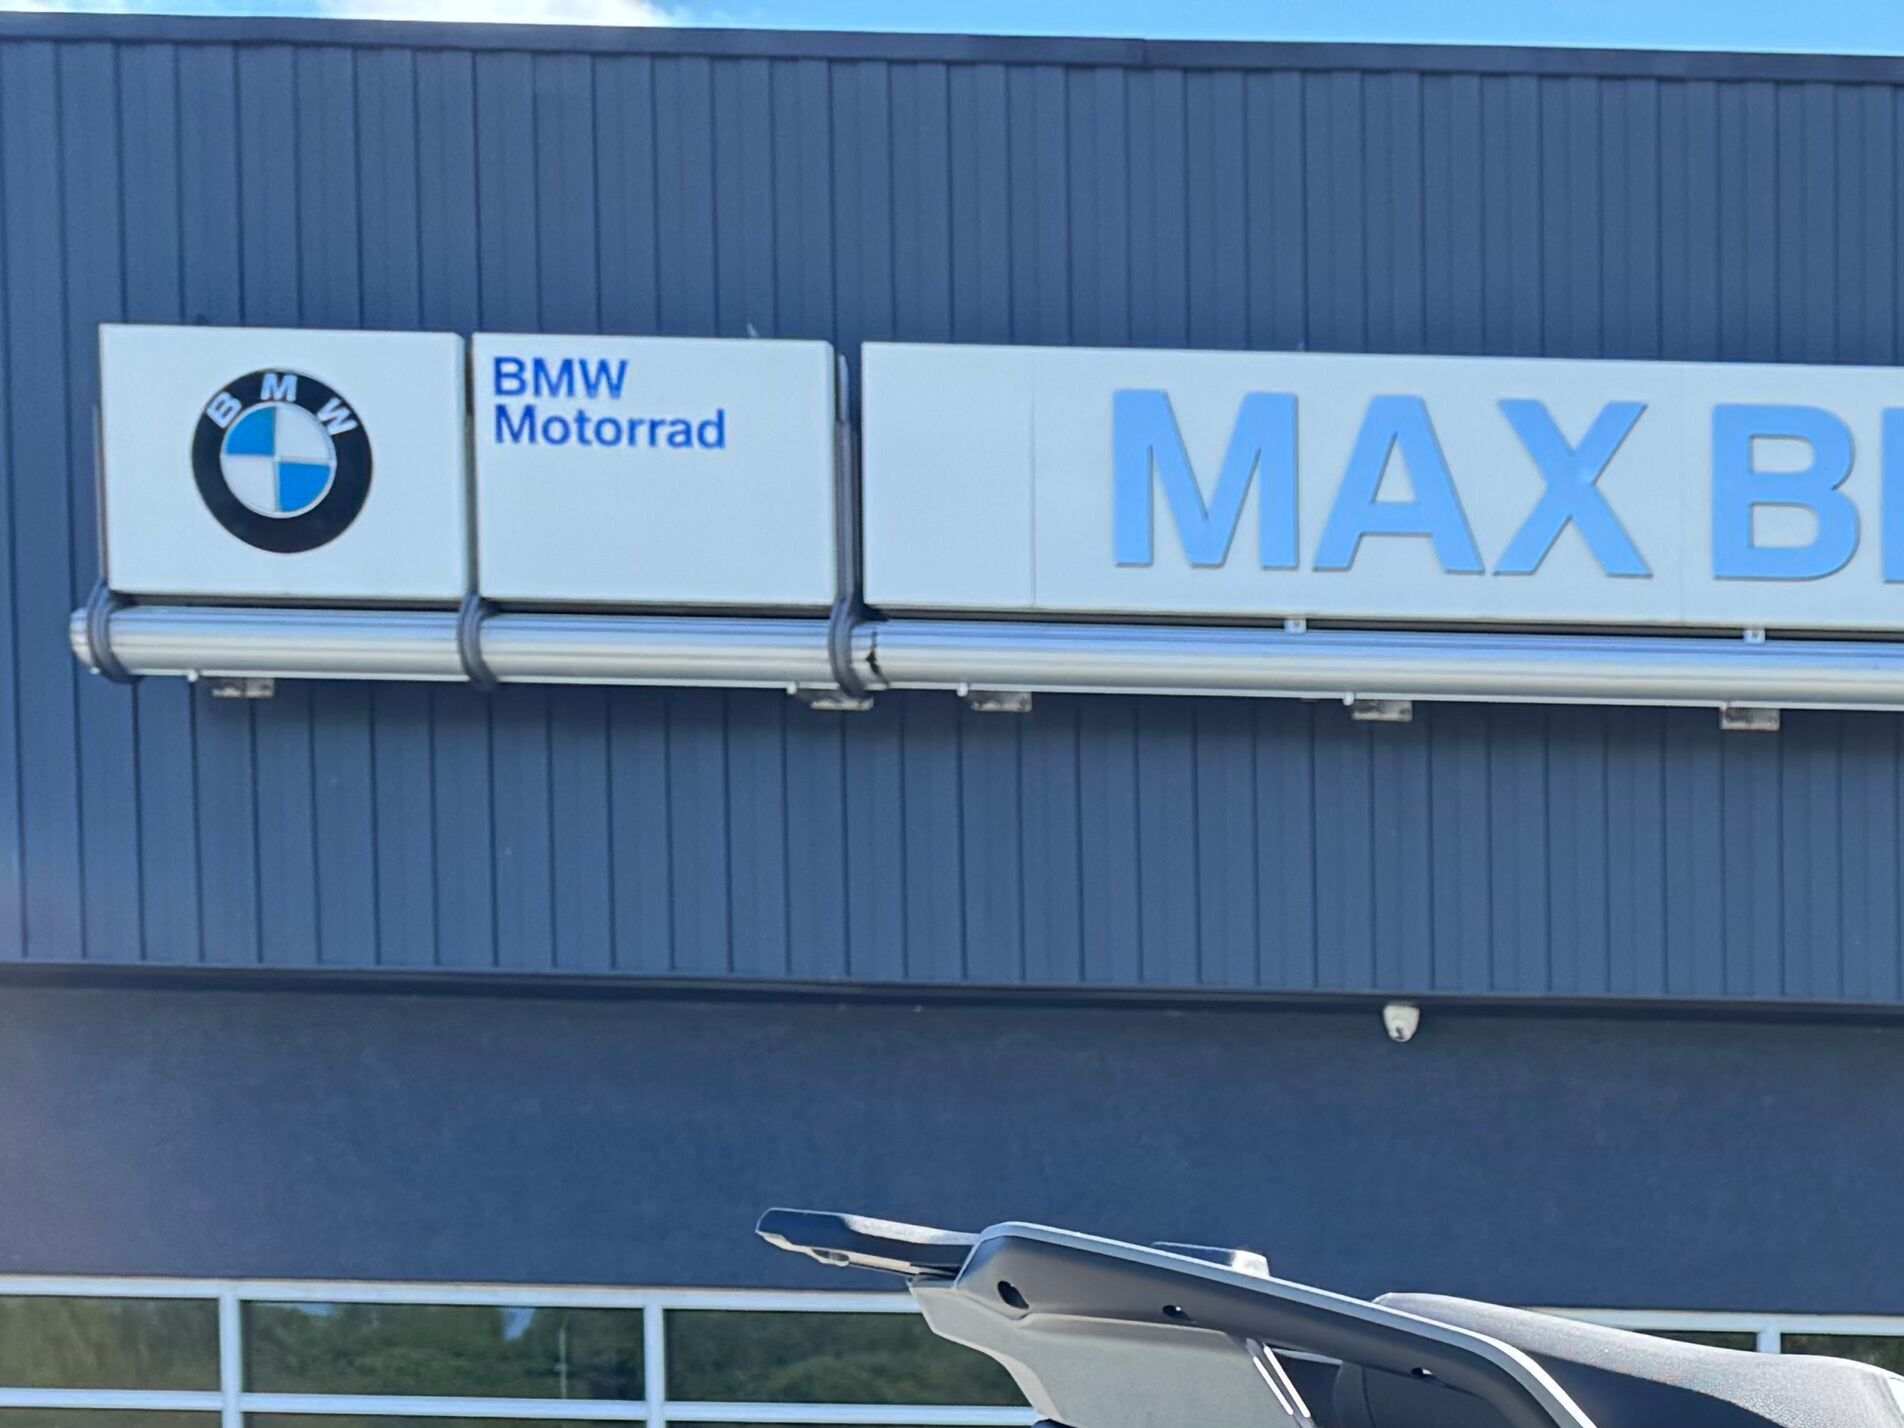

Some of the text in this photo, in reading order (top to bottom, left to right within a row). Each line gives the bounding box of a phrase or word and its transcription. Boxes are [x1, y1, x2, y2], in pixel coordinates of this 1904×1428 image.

[493, 356, 631, 399] BMW
[206, 373, 357, 437] BMW
[493, 404, 726, 449] Motorrad
[1111, 387, 1654, 578] MAX
